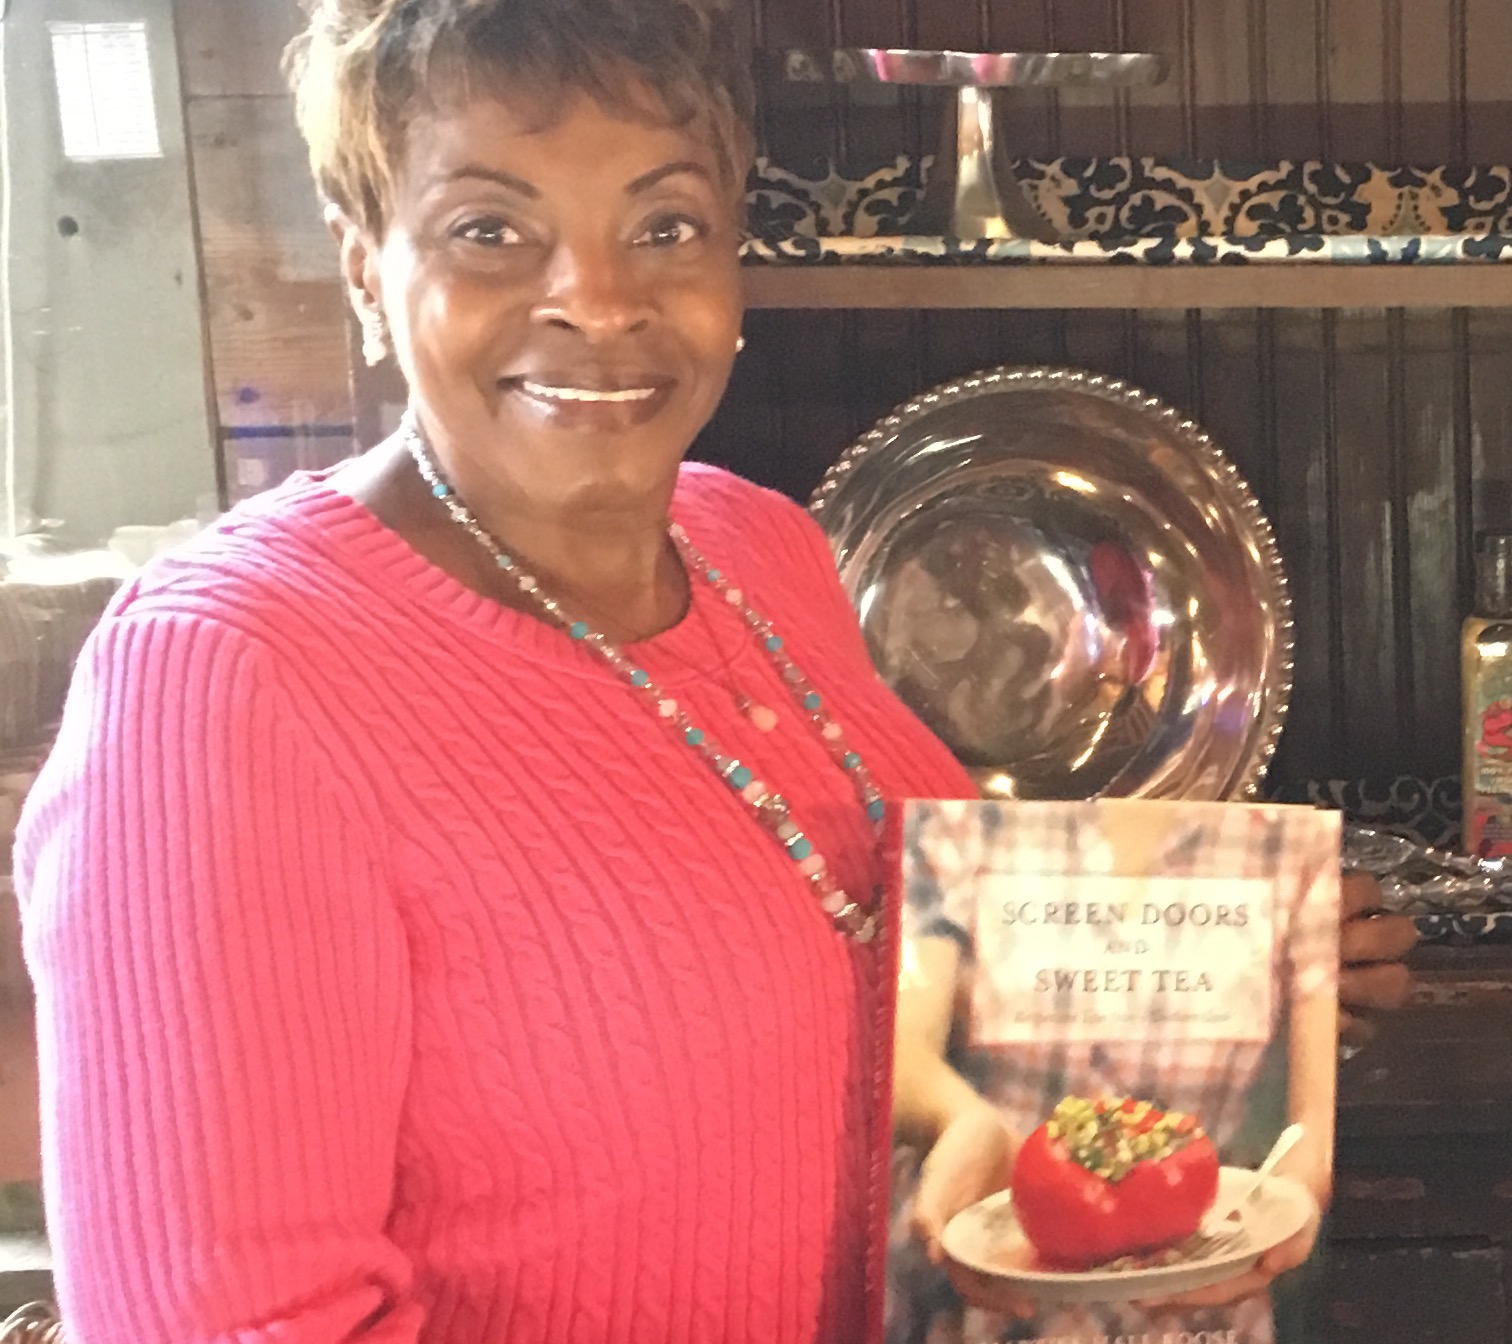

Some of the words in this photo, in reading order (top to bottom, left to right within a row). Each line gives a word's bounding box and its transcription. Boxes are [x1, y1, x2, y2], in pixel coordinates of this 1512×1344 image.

[1001, 900, 1126, 926] SCREEN
[1141, 901, 1250, 927] DOORS
[1034, 968, 1143, 993] SWEET
[1151, 968, 1215, 993] TEA
